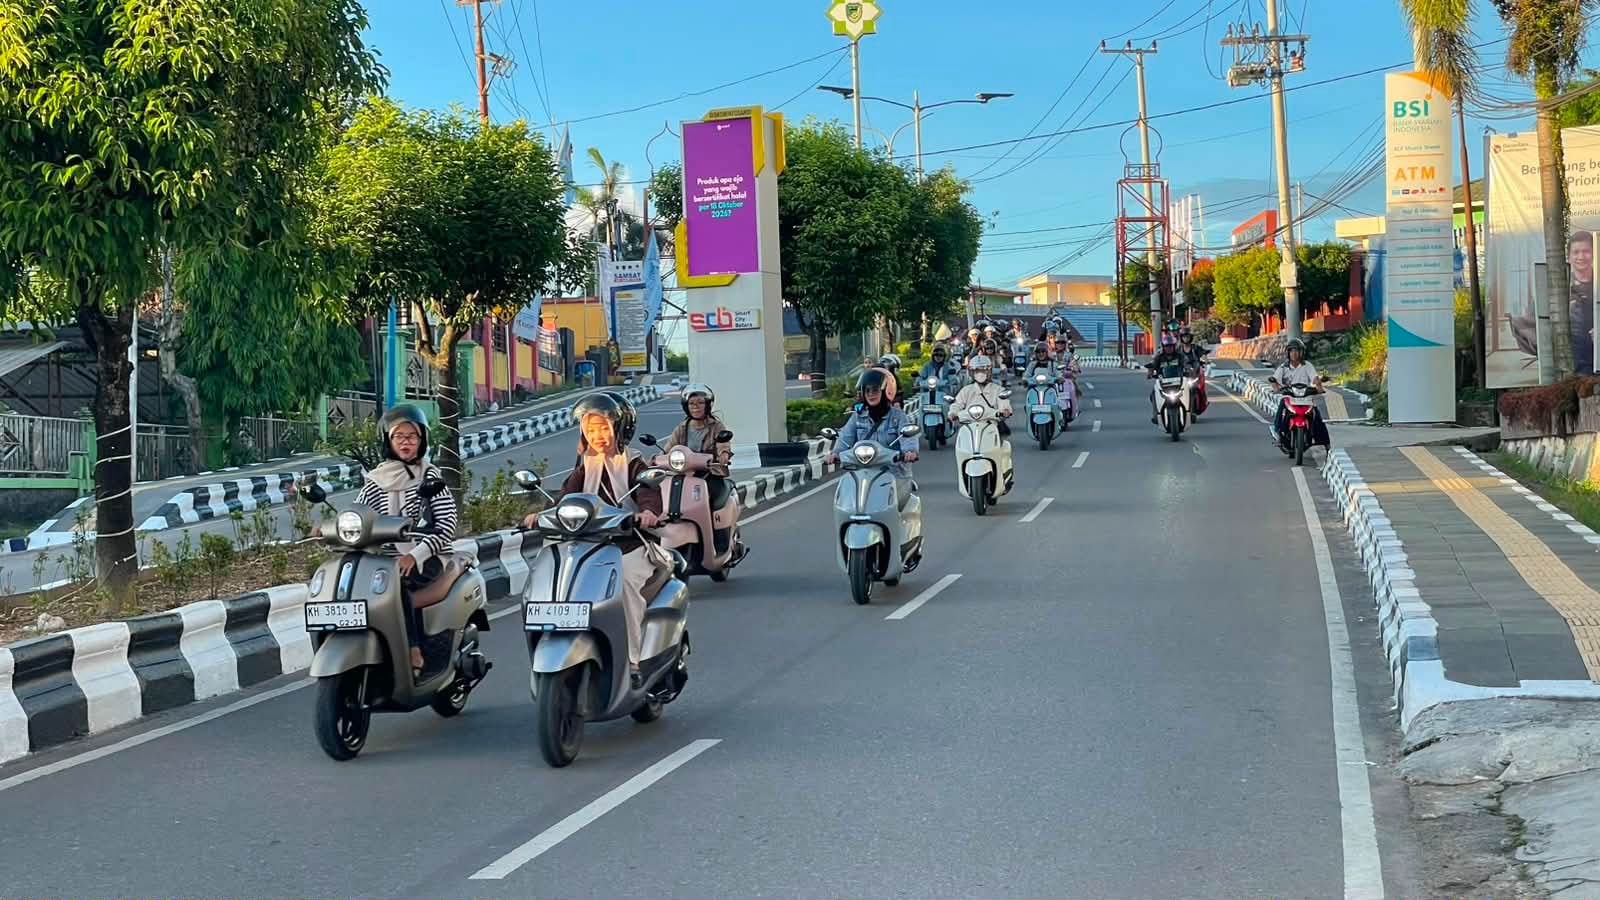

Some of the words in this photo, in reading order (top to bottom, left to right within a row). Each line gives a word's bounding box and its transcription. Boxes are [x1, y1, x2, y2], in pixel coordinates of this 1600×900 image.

[1393, 98, 1430, 118] BSI
[1394, 165, 1436, 181] ATM
[697, 176, 719, 185] Produk
[704, 187, 719, 195] yang
[693, 193, 730, 202] bersertifikat
[718, 201, 743, 209] Oktober
[308, 606, 320, 617] KH
[325, 605, 347, 616] 3816
[353, 604, 364, 615] IC
[528, 606, 540, 616] KH
